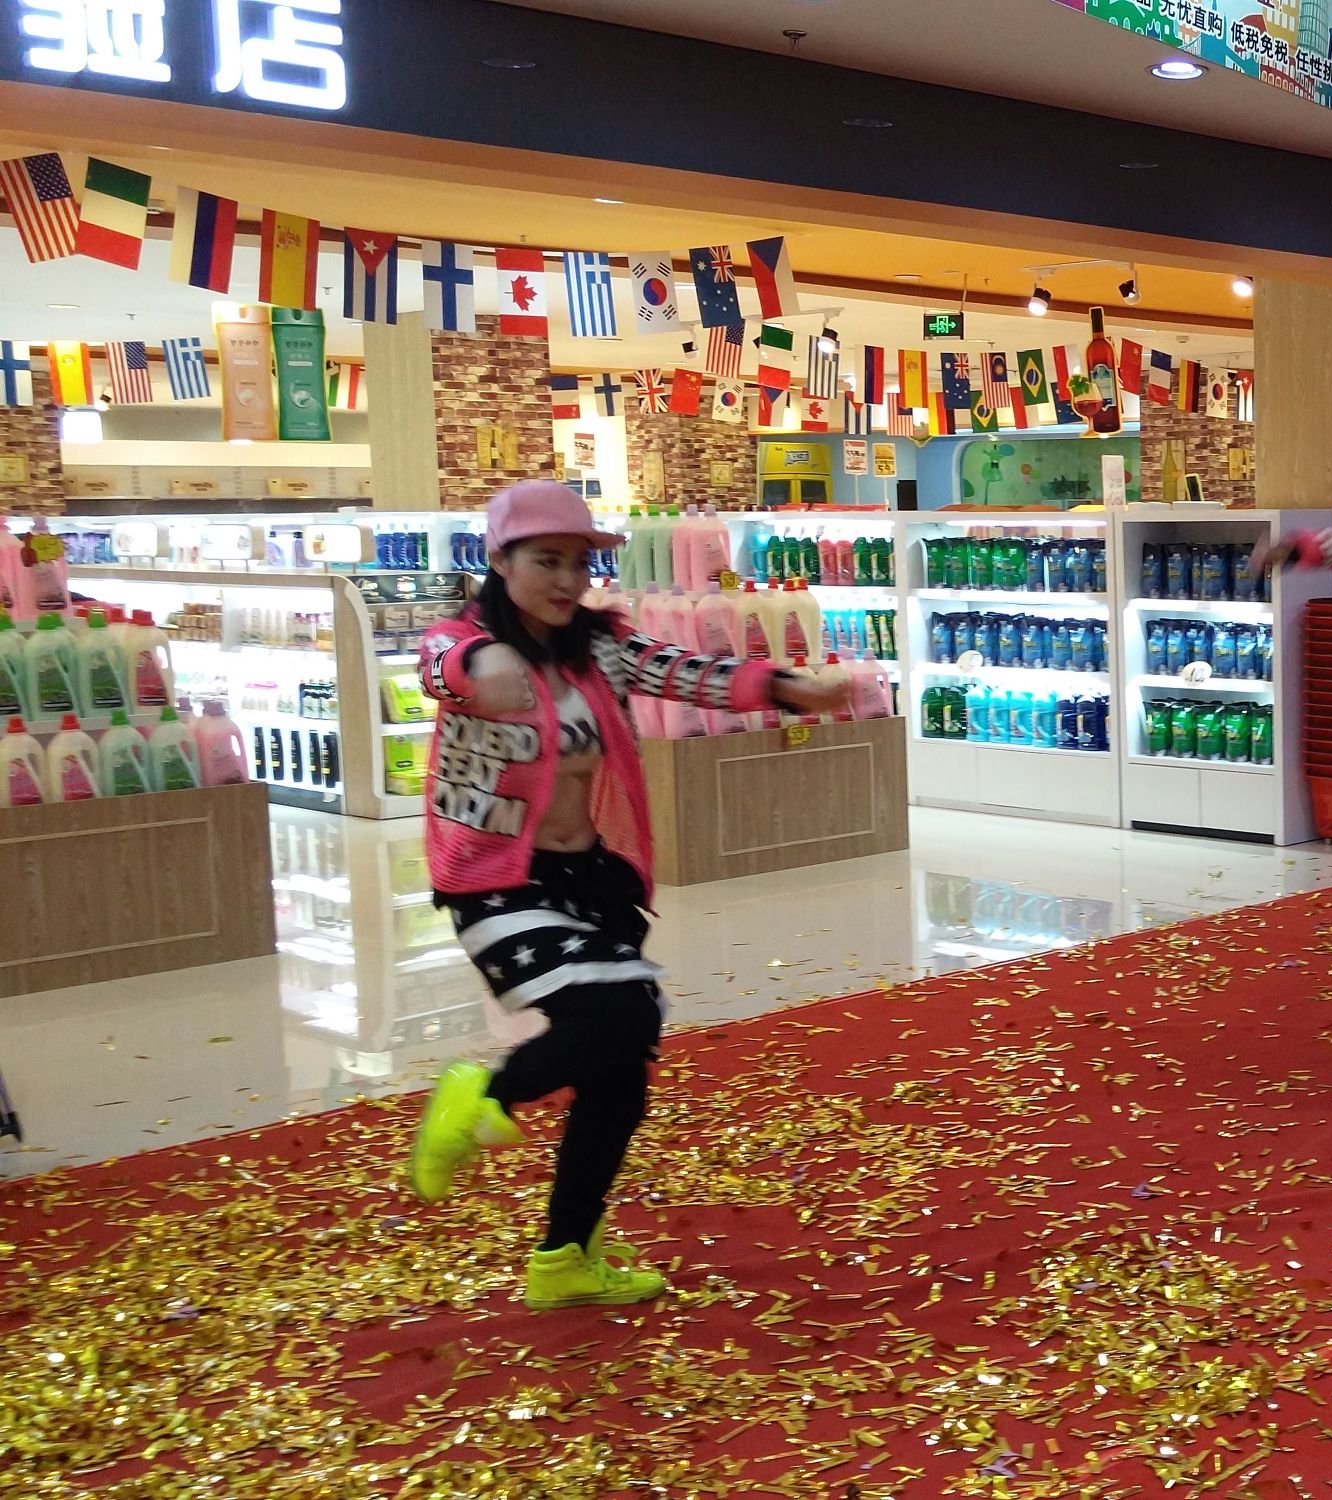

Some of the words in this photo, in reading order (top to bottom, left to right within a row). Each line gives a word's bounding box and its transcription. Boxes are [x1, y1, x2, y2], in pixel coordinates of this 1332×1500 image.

[1160, 0, 1223, 37] 无忧直购
[1230, 21, 1288, 64] 低税免税
